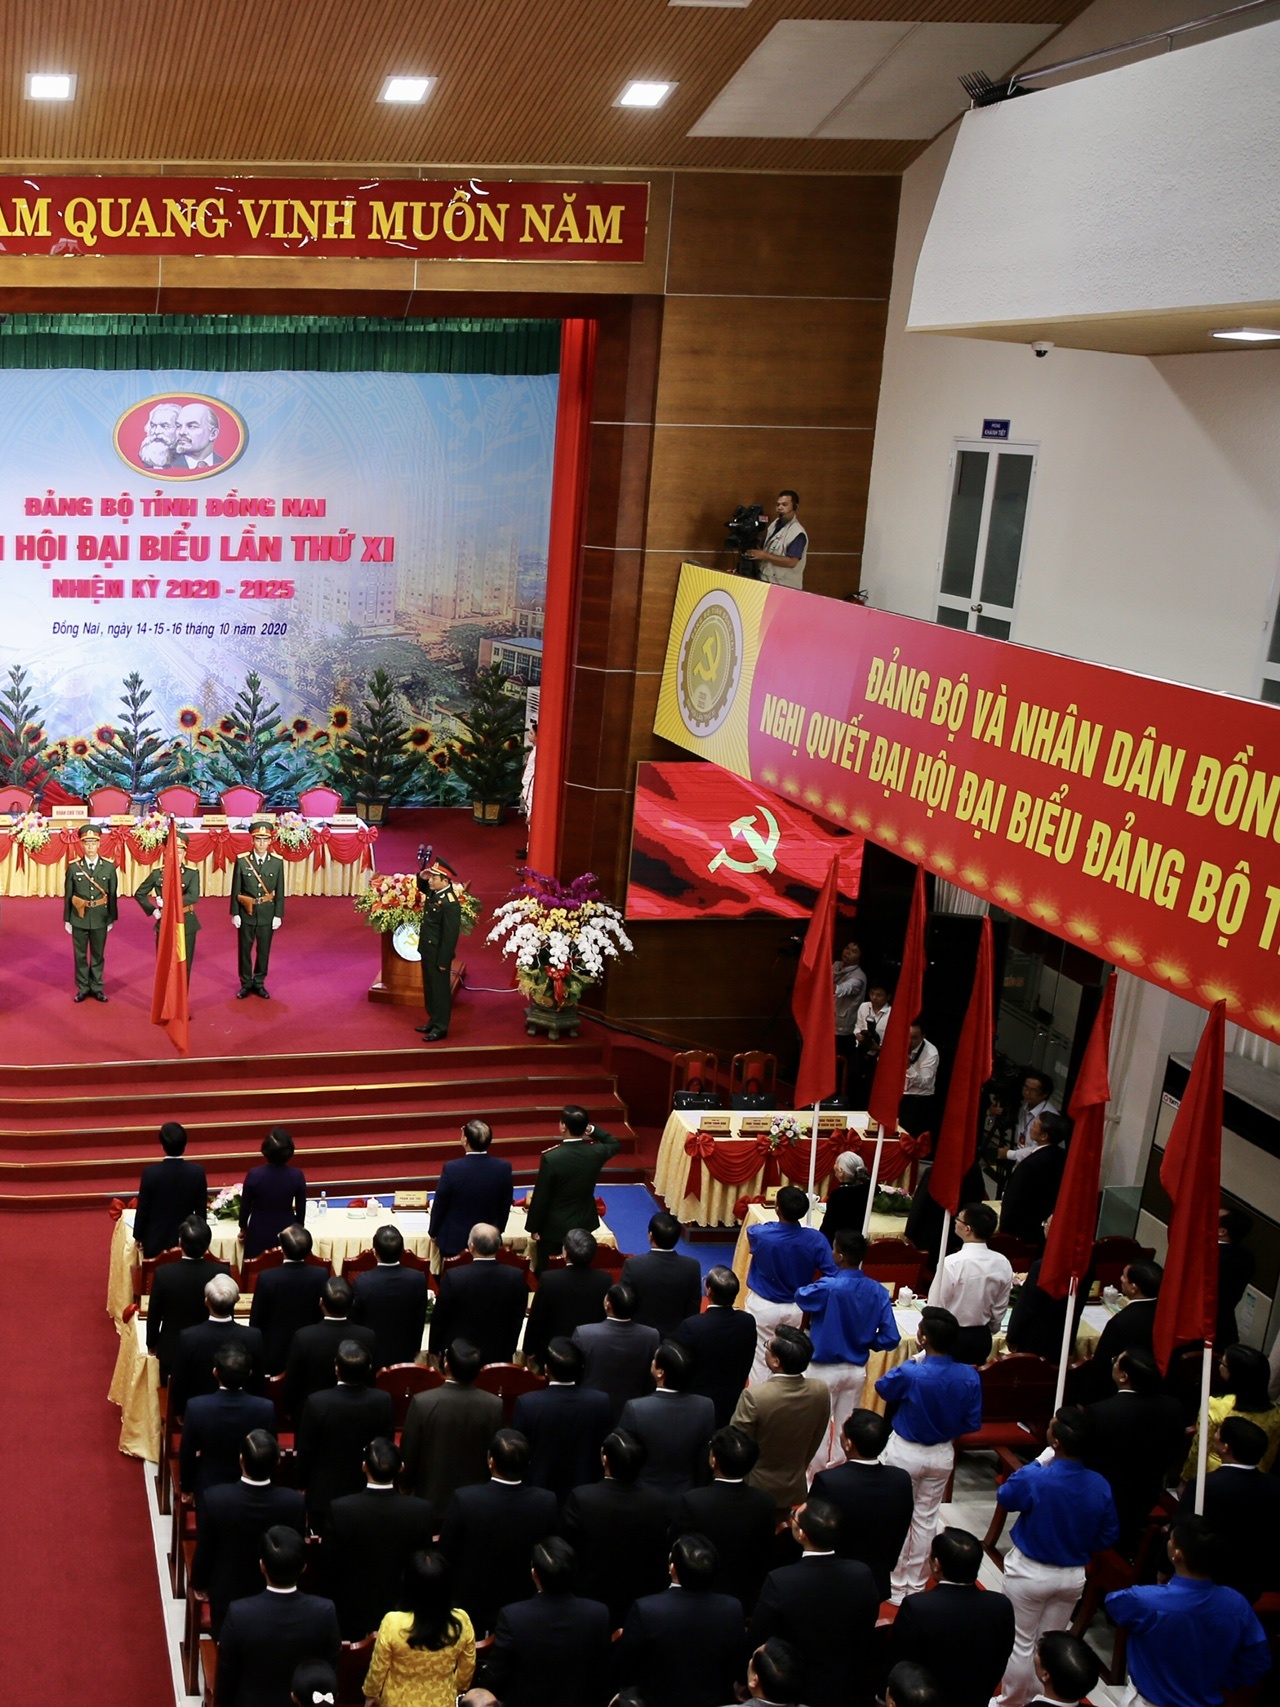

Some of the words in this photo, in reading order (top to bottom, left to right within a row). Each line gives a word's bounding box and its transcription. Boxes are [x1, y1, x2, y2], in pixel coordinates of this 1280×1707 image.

[64, 197, 229, 247] QUANG
[238, 199, 357, 240] VINH
[367, 190, 510, 242] MUÔN
[519, 192, 625, 244] NĂM
[24, 489, 94, 518] ĐẢNG
[100, 492, 134, 525] BỘ
[140, 489, 199, 518] TỈNH
[205, 488, 276, 518] ĐỒNG
[281, 498, 327, 518] NAI
[14, 528, 68, 570] HỘI
[77, 535, 130, 569] ĐẠI
[139, 521, 212, 563] BIỂU
[220, 523, 283, 563] LẦN
[290, 527, 357, 563] THỨ
[360, 535, 395, 563] XI
[51, 574, 125, 605] NHIỆM
[131, 574, 161, 599] KỲ
[165, 579, 222, 599] 2020
[239, 579, 296, 600] 2025
[52, 620, 80, 638] Đồng
[107, 622, 133, 639] ngày
[185, 622, 215, 639] tháng
[219, 622, 230, 635] 10
[233, 623, 257, 636] năm
[260, 622, 288, 636] 2020
[864, 646, 931, 719] ĐẢNG
[930, 673, 969, 743] BỘ
[971, 683, 1008, 748] VÀ
[1010, 703, 1104, 778] NHÂN
[1102, 726, 1187, 807] DÂN
[1185, 744, 1280, 845] ĐỒN
[759, 693, 807, 757] NGHỊ
[805, 713, 870, 774] QUYẾT
[868, 735, 912, 798] ĐẠI
[909, 749, 957, 818] HỘI
[954, 770, 1007, 840] ĐẠI
[1006, 783, 1083, 865] BIỂU
[1081, 811, 1187, 911] ĐẢNG
[1186, 859, 1252, 949] BỘ
[1258, 884, 1280, 956] T
